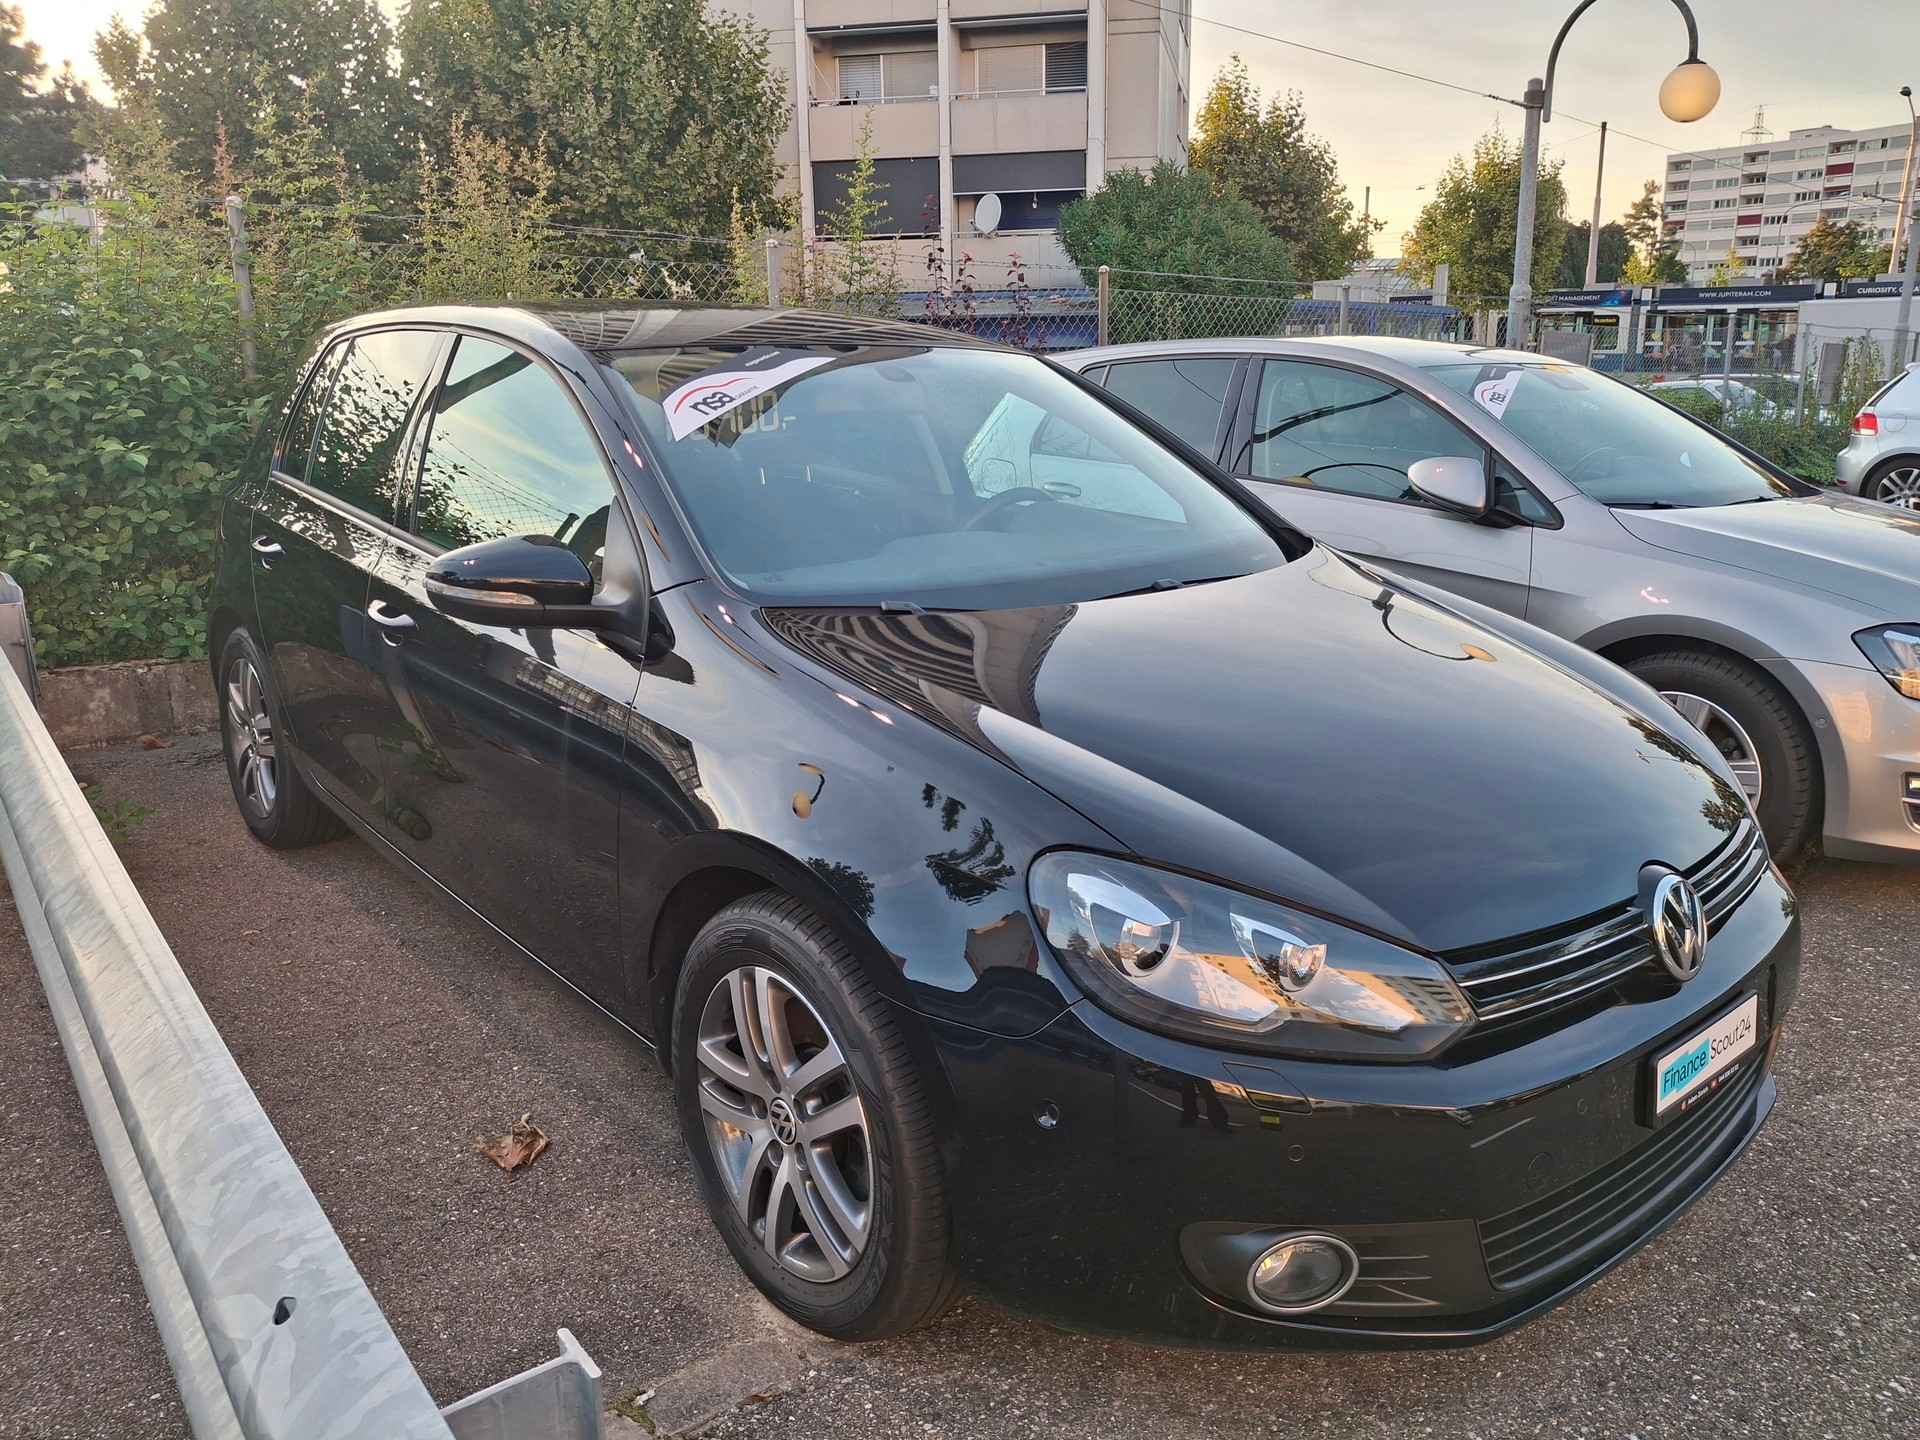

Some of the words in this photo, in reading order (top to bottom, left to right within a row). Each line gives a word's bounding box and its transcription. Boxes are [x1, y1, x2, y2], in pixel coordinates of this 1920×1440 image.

[1698, 290, 1772, 298] WWW.JUPITERAM.COM
[1857, 286, 1898, 294] CURIOSITY,
[734, 385, 758, 399] GARANTIE
[689, 391, 737, 416] nsa
[1663, 1050, 1707, 1093] Finance
[1710, 1014, 1752, 1060] Scout24
